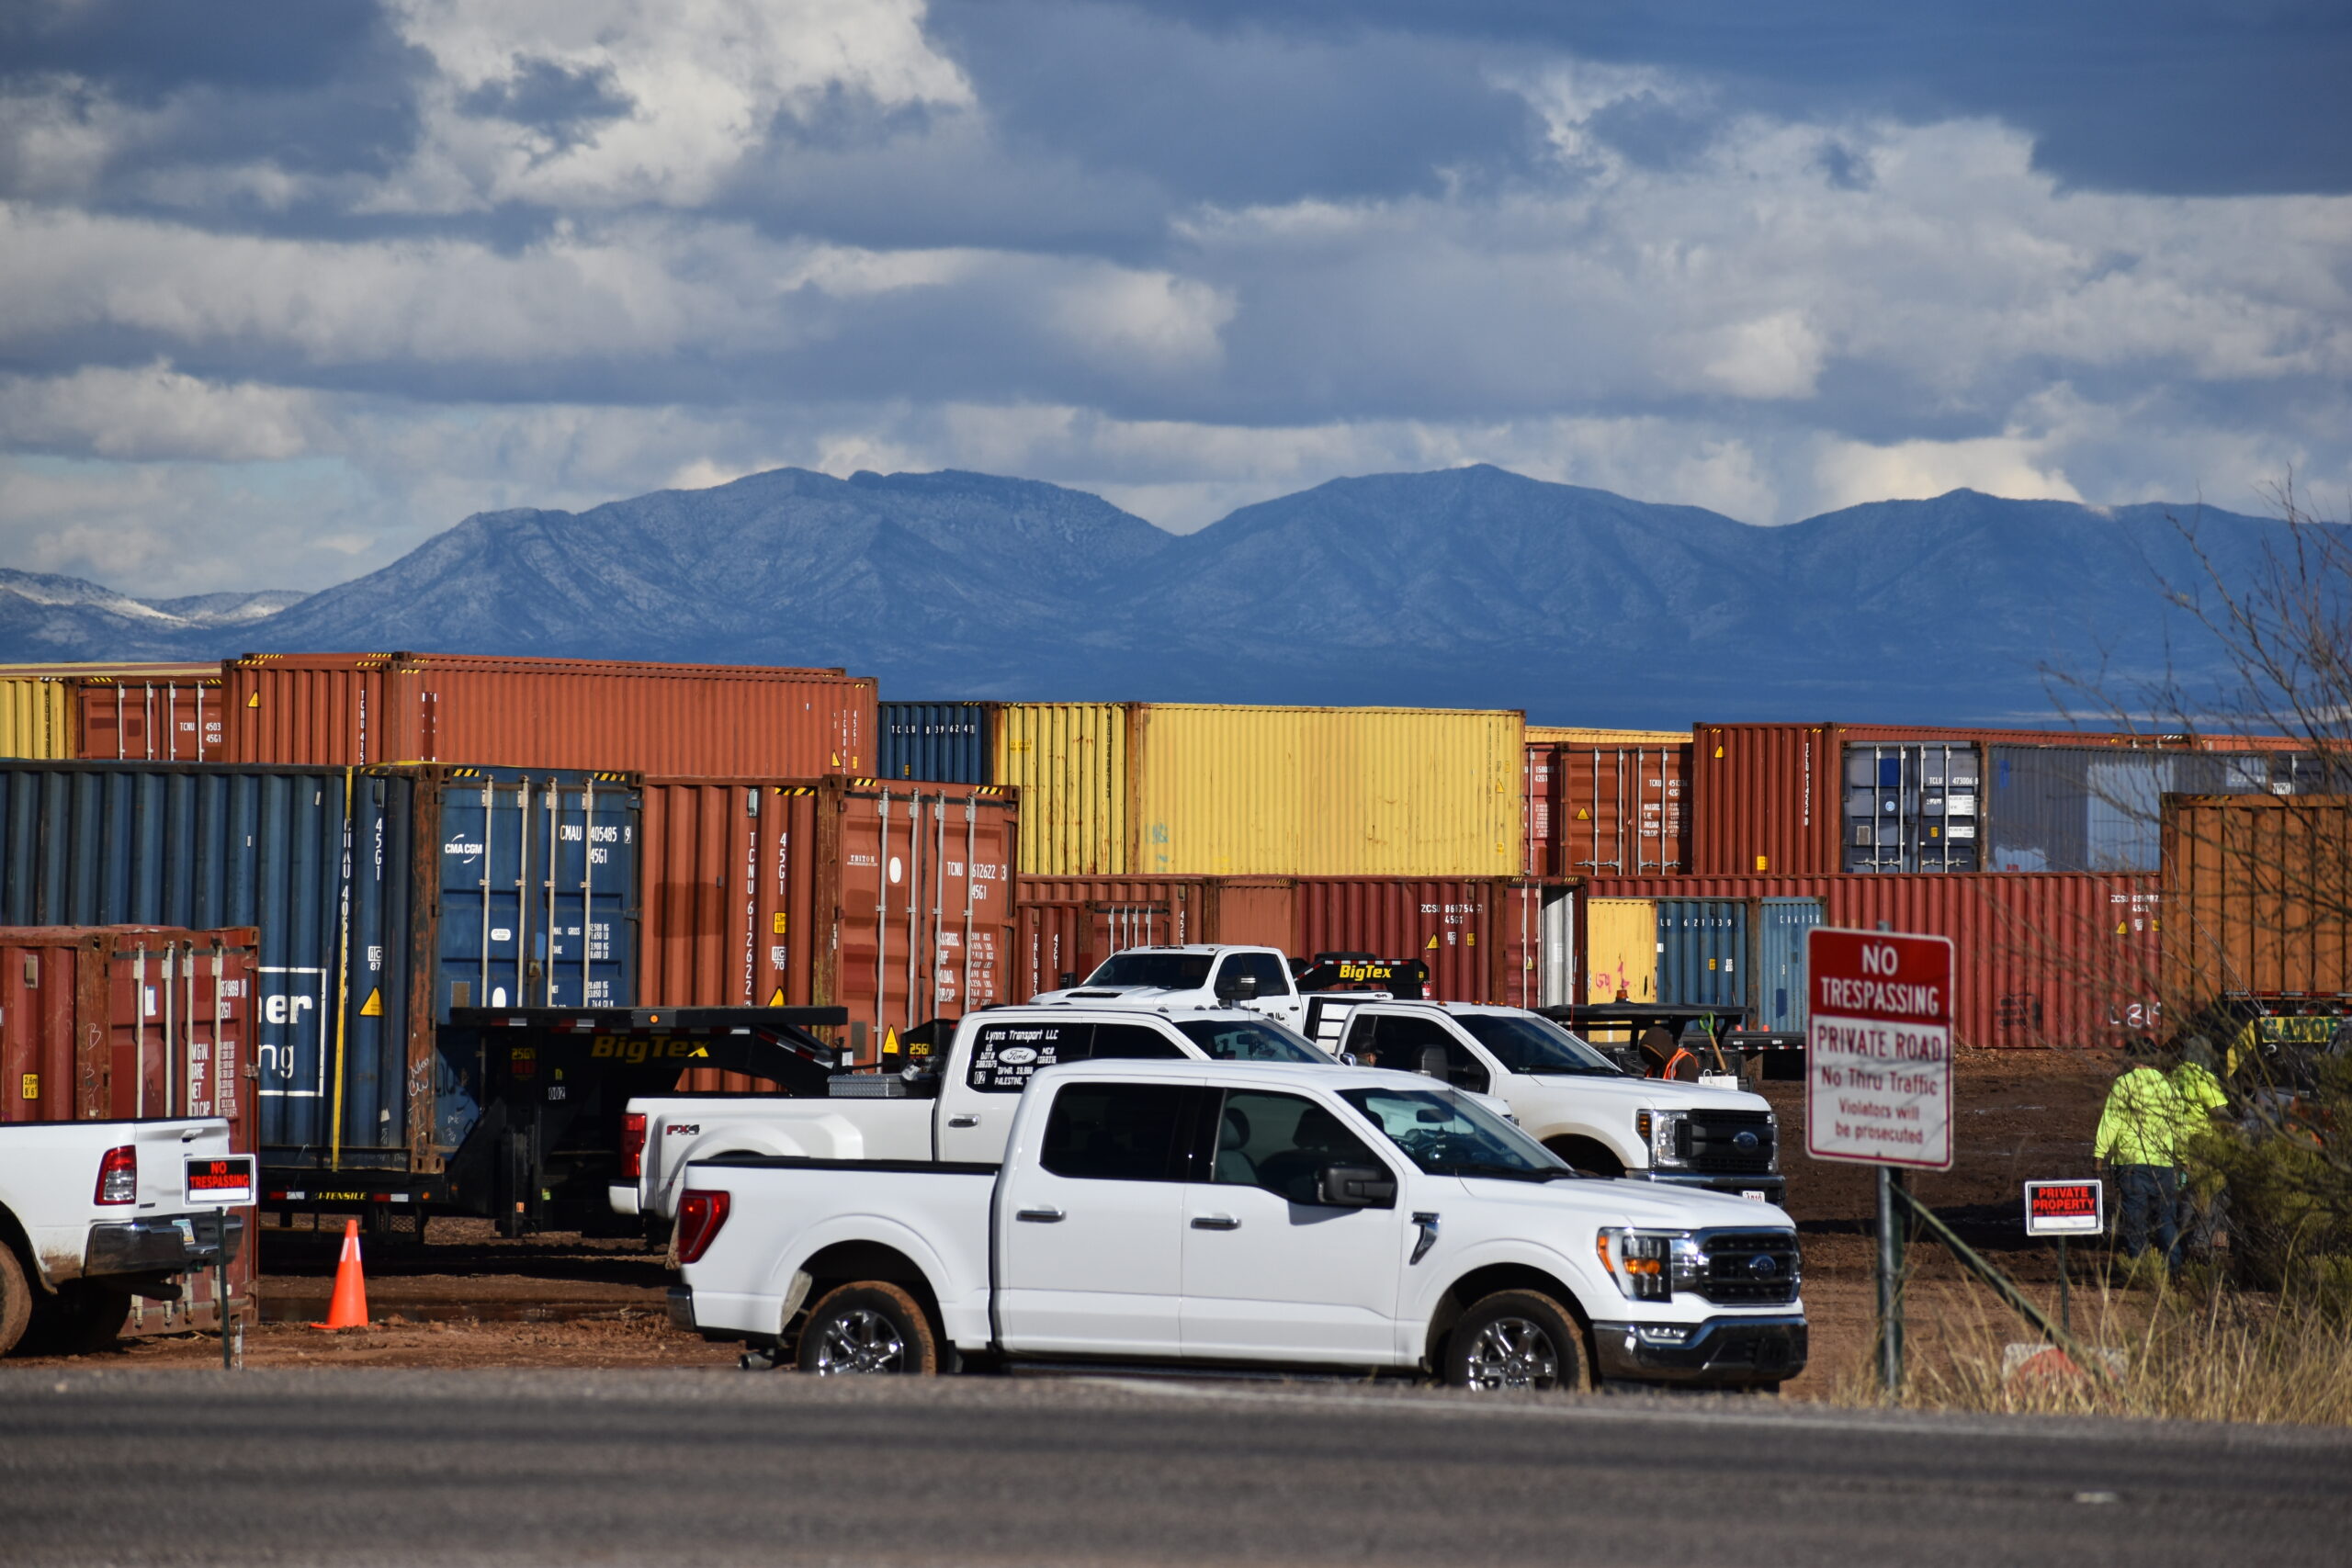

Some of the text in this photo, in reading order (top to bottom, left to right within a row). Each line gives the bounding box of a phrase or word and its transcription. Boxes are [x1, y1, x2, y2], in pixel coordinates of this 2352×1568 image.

[179, 722, 195, 732] TCNU
[560, 825, 632, 843] CMAU 405485 9
[375, 818, 383, 881] 45G1
[445, 843, 482, 854] CMA CGM
[590, 848, 607, 864] 45G1
[747, 831, 755, 895] TCNU
[778, 832, 787, 896] 45G1
[850, 854, 876, 863] TRITON
[947, 861, 963, 877] TCNU
[972, 863, 996, 879] 612622
[1420, 904, 1441, 913] ZCSU
[745, 900, 753, 996] 612622
[369, 962, 381, 971] 87
[774, 961, 786, 970] 70
[1861, 943, 1899, 976] NO
[1339, 964, 1392, 982] BigTex
[1820, 976, 1939, 1017] TRESPASSING
[258, 994, 312, 1024] er
[1009, 1029, 1044, 1043] Transport
[1045, 1029, 1059, 1040] LLC
[1816, 1024, 1943, 1063] PRIVATE ROAD
[590, 1035, 711, 1065] BigTex
[985, 1043, 993, 1052] US
[1007, 1049, 1030, 1061] Ford
[974, 1071, 986, 1085] 02
[1821, 1065, 1939, 1097] No Thru Traffic
[1838, 1097, 1920, 1122] Violators will
[666, 1124, 700, 1134] FX4
[1835, 1121, 1924, 1145] be prosecuted
[209, 1161, 228, 1175] NO
[189, 1175, 250, 1189] TRESPASSING
[315, 1190, 368, 1201] I-TENSILE
[2039, 1186, 2089, 1199] PRIVATE
[2032, 1198, 2095, 1211] PROPERTY
